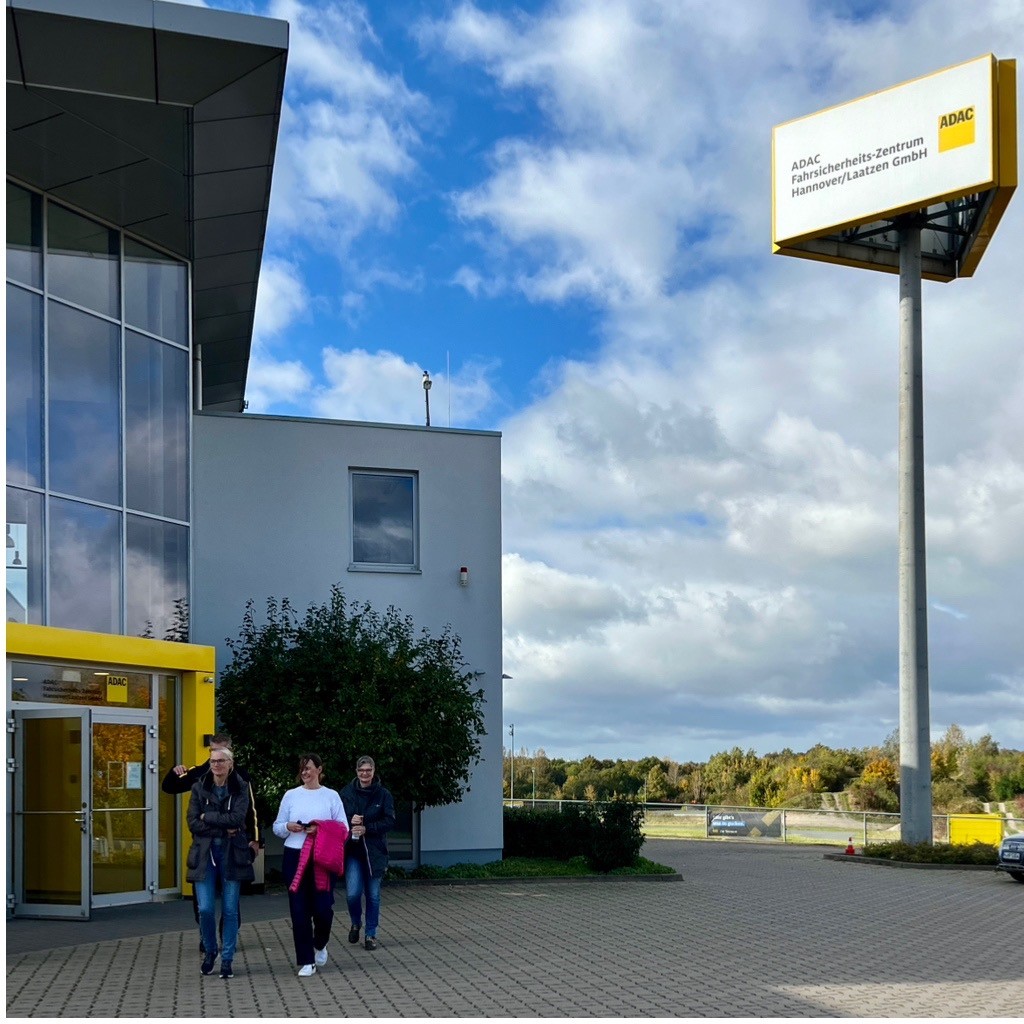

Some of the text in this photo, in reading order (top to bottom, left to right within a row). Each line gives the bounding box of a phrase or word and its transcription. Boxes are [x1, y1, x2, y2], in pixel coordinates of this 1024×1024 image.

[939, 107, 974, 129] ADAC
[791, 136, 924, 185] Fahrsicherheits-Zentrum
[791, 154, 821, 171] ADAC
[791, 148, 928, 198] Hannover/Laatzen GmbH
[108, 676, 127, 686] ADAC
